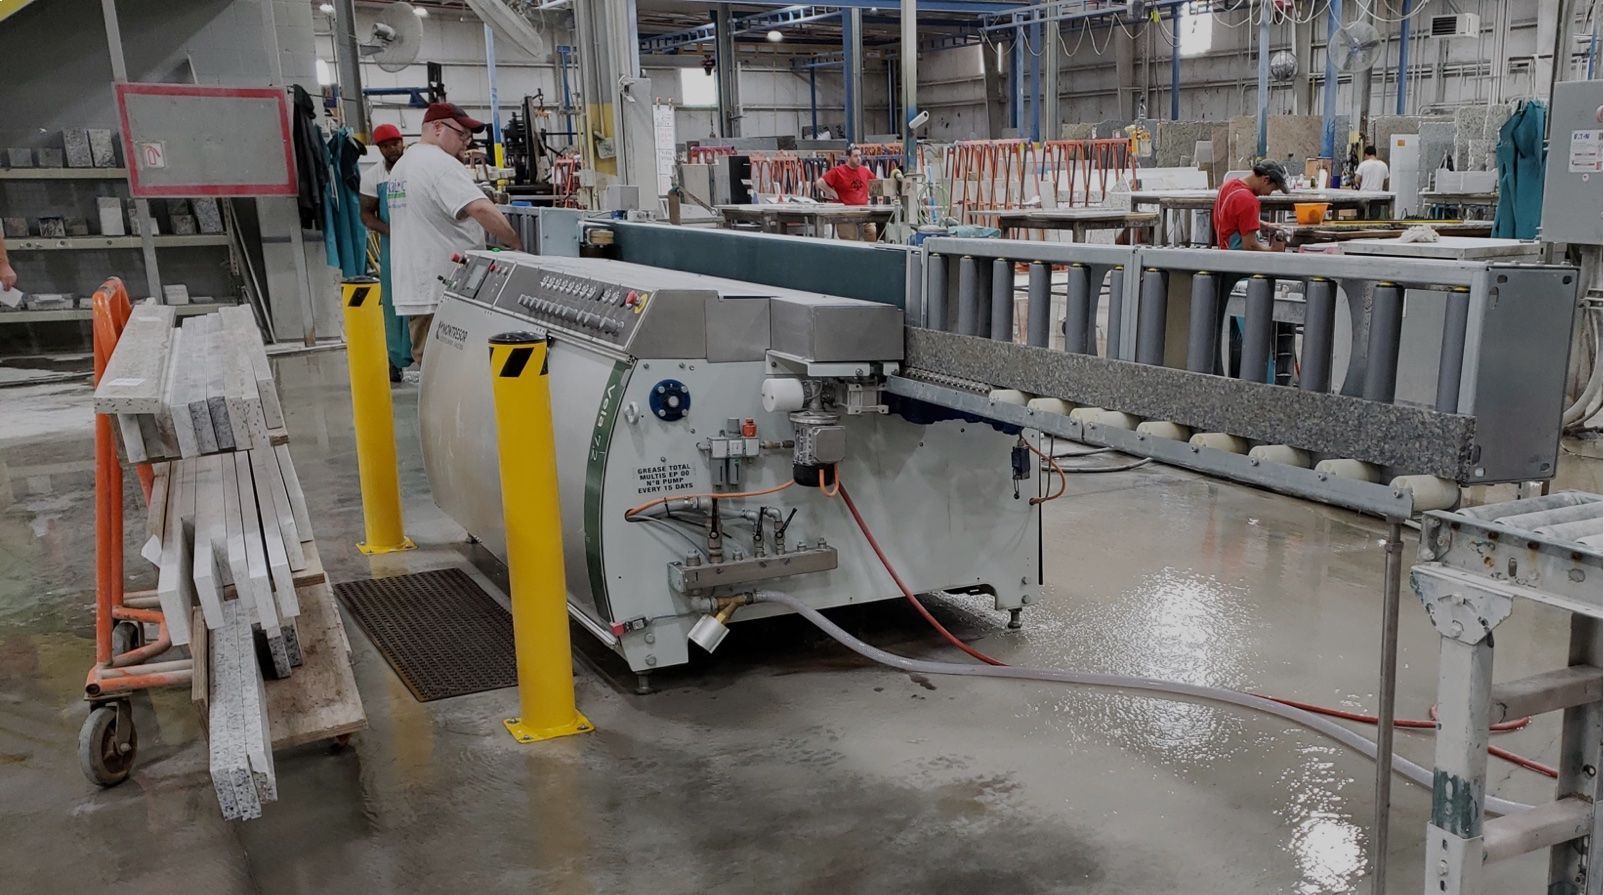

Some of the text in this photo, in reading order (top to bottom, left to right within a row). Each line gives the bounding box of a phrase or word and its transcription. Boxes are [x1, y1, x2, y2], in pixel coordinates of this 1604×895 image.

[597, 384, 616, 427] Vela
[637, 466, 667, 474] GREASE
[638, 486, 661, 494] EVERY
[675, 482, 694, 490] DAYS
